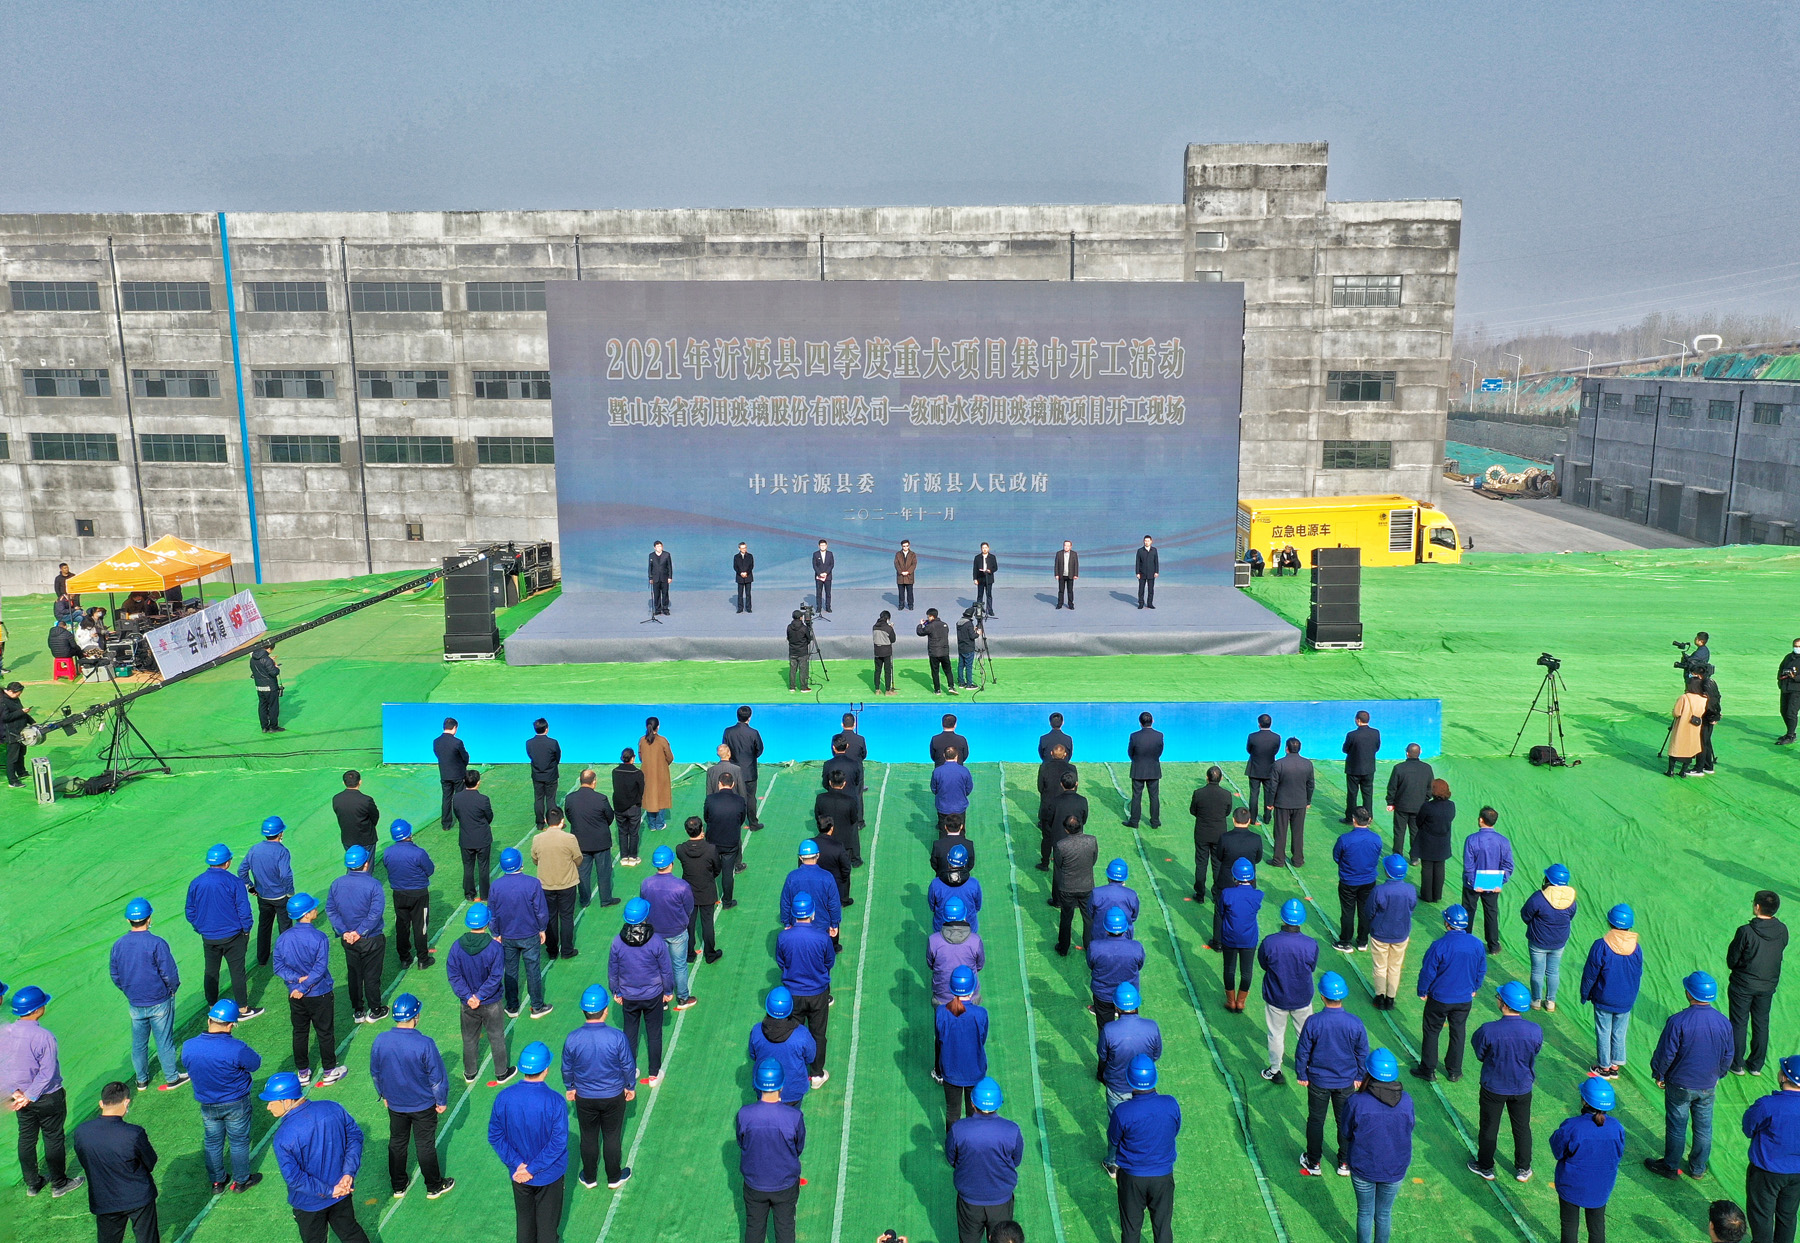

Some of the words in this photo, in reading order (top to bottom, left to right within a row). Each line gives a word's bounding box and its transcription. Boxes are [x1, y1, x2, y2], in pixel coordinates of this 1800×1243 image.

[606, 336, 1186, 381] 2021年沂源县四季度重大项目集中开工活动
[608, 395, 1186, 427] 暨山东省药用玻璃股份有限公司一级耐水药用玻璃瓶项目开工现场
[748, 472, 876, 495] 中共沂源县委
[902, 472, 1049, 494] 沂源县人民政府
[1272, 523, 1331, 538] 应急电源车
